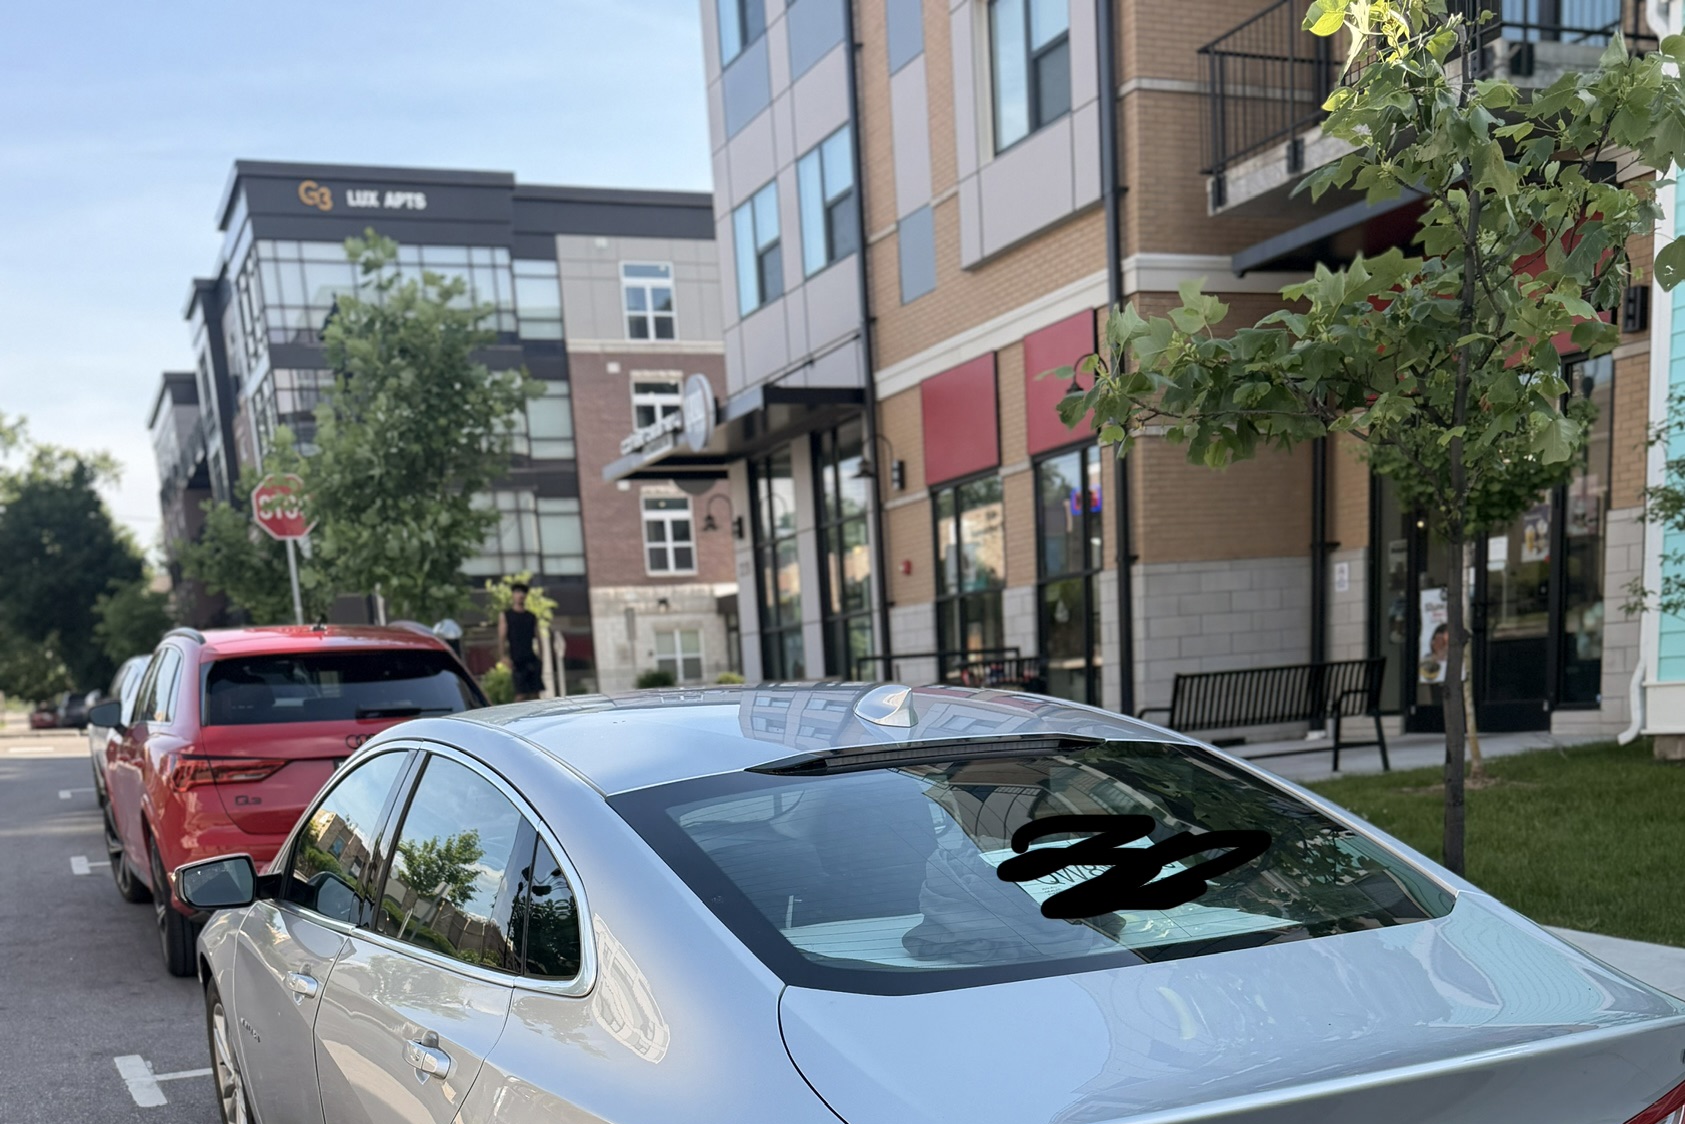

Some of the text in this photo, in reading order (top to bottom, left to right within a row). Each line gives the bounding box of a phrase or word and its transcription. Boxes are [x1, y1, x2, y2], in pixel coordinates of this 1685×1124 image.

[297, 180, 428, 212] G3 LUX APTS
[235, 795, 262, 806] Q3
